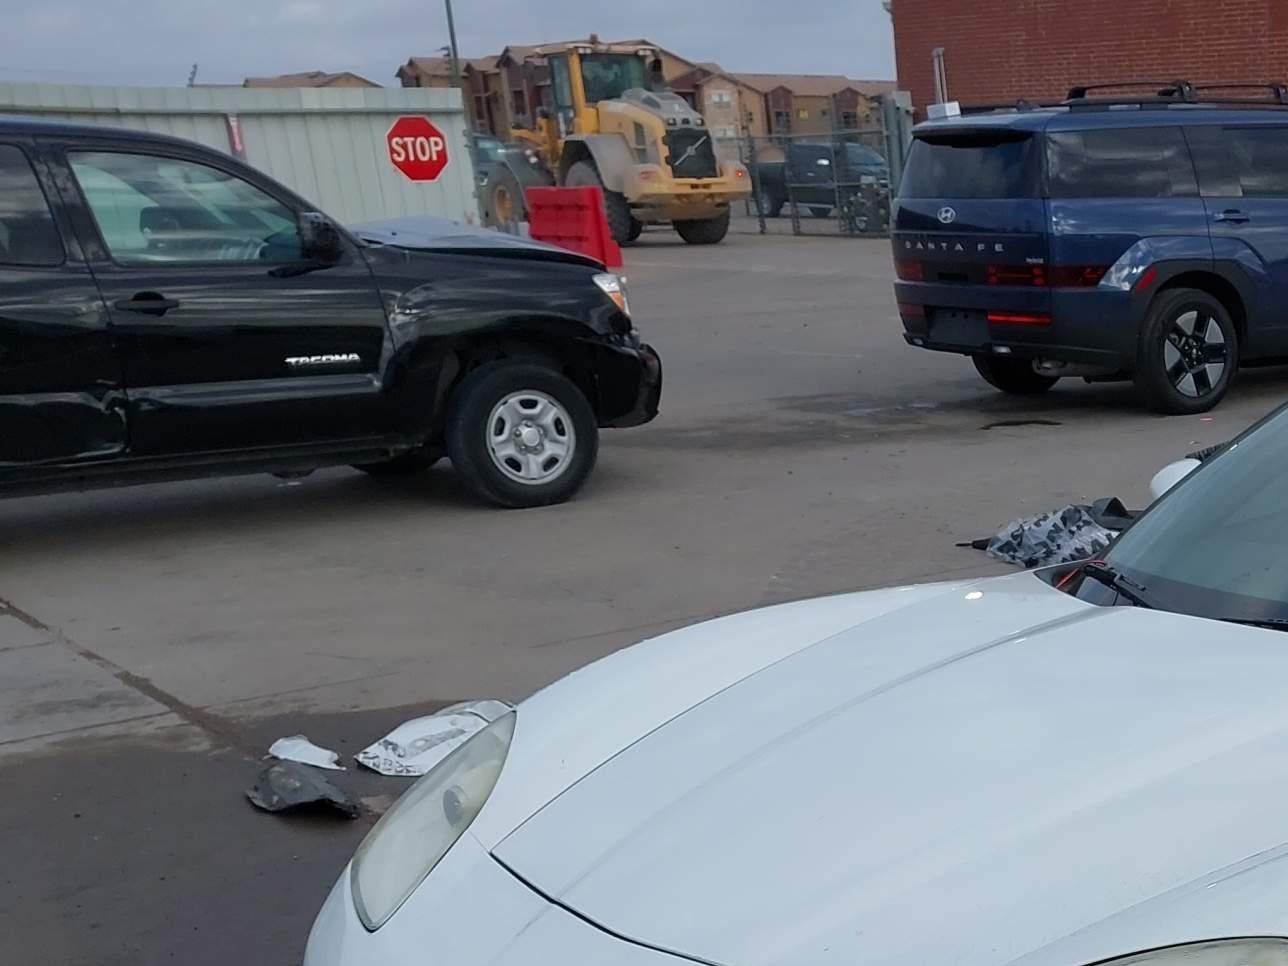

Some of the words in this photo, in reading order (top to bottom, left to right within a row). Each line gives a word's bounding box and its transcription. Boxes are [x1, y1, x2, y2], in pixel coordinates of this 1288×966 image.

[391, 136, 443, 162] STOP
[904, 240, 964, 251] SANTA
[977, 243, 1004, 252] FE
[284, 352, 361, 365] TACOMA
